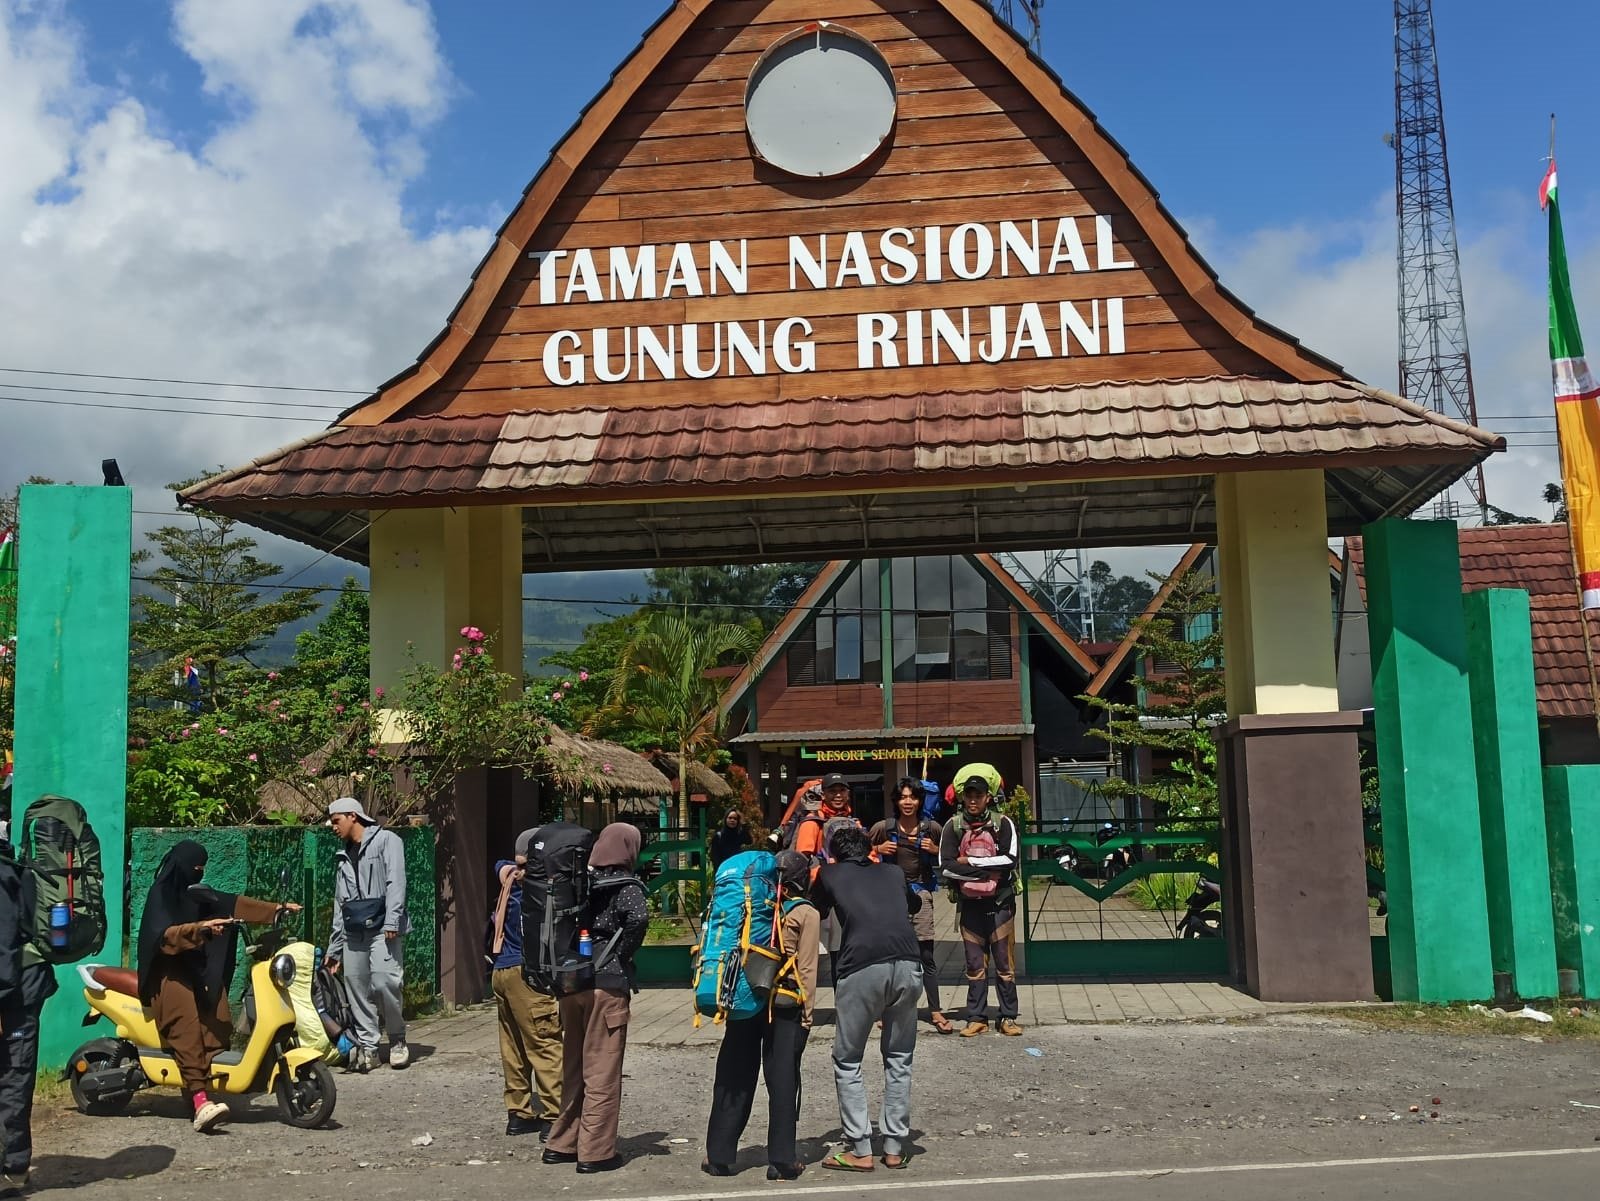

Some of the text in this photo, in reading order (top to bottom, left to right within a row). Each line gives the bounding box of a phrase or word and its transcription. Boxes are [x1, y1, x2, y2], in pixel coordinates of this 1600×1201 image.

[528, 214, 1136, 305] TAMAN NASIONAL
[542, 298, 1126, 386] GUNUNG RINJANI
[816, 748, 943, 761] RESORT SEMBALUN
